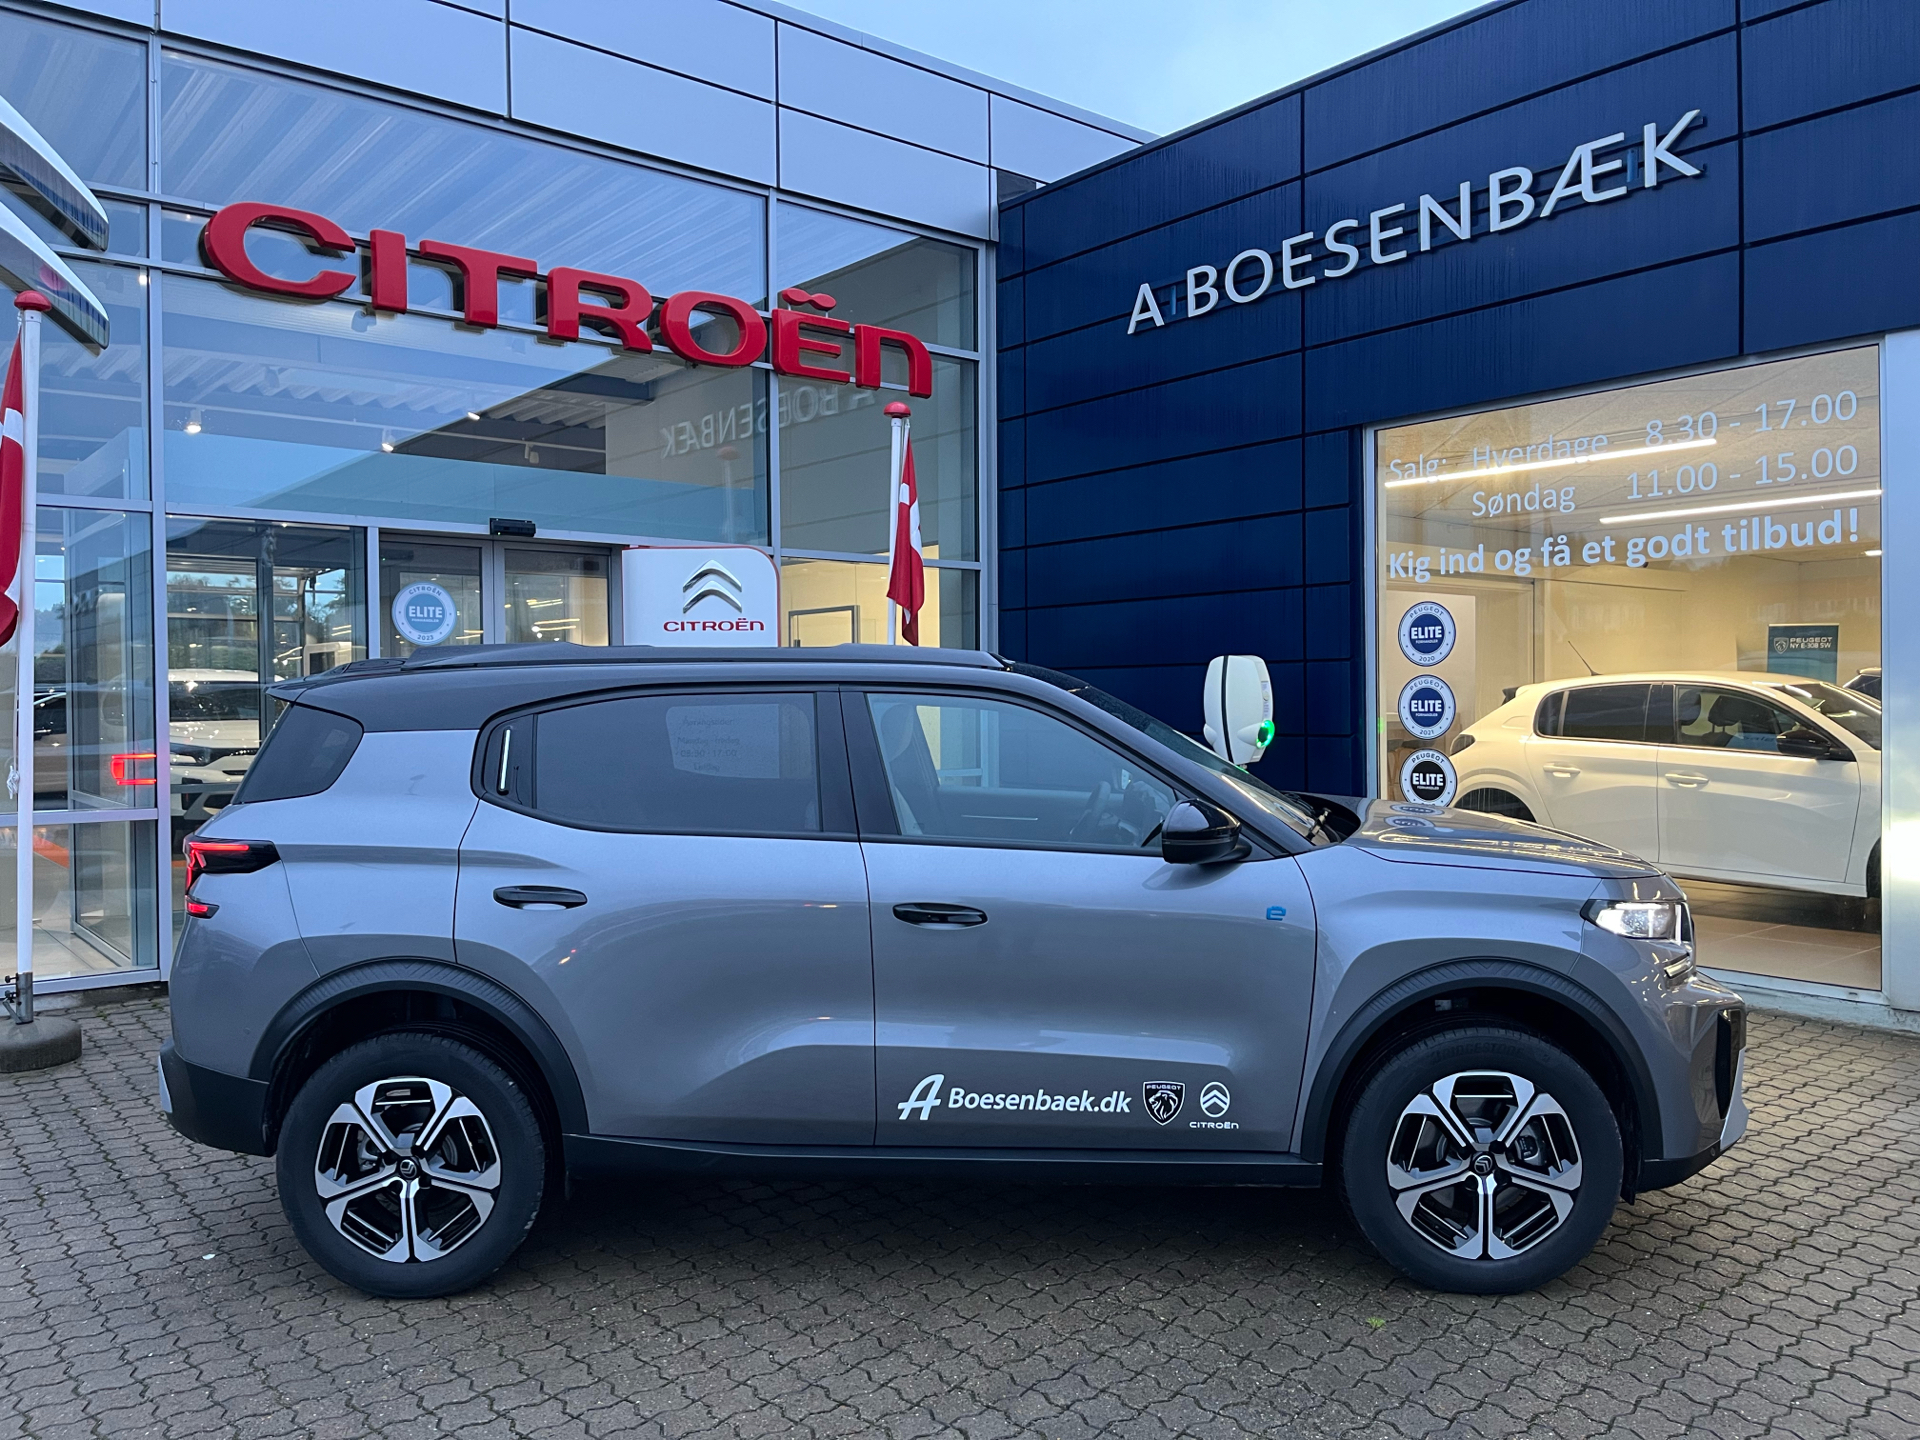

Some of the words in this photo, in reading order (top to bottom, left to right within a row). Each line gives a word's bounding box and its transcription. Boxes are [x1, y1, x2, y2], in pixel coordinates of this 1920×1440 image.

[1127, 283, 1165, 334] A
[1187, 109, 1700, 317] BOESENBÆK
[201, 202, 932, 398] CITROËN
[1473, 434, 1609, 470] Hverdage
[1645, 411, 1717, 447] 8.30
[1755, 390, 1857, 432] 17.00
[1472, 483, 1576, 517] Søndag
[1627, 462, 1718, 499] 11.00
[1755, 445, 1858, 485] 15.00
[1390, 550, 1431, 582] Kig
[1440, 544, 1485, 575] ind
[1494, 547, 1532, 576] og
[1541, 535, 1571, 567] få
[1582, 535, 1616, 564] et
[1626, 524, 1710, 568] godt
[1721, 508, 1859, 552] tilbud!
[409, 606, 443, 618] ELITE
[1409, 605, 1445, 618] PEUGEOT
[663, 617, 765, 632] CITROËN
[1411, 625, 1442, 639] ELITE
[1418, 655, 1435, 663] 2020
[1409, 679, 1445, 691] PEUGEOT
[1411, 699, 1442, 712] ELITE
[1411, 752, 1446, 764] PEUGEOT
[1412, 772, 1444, 786] ELITE
[948, 1087, 1132, 1113] Boesenbaek.dk
[1189, 1121, 1240, 1130] CITROËN
